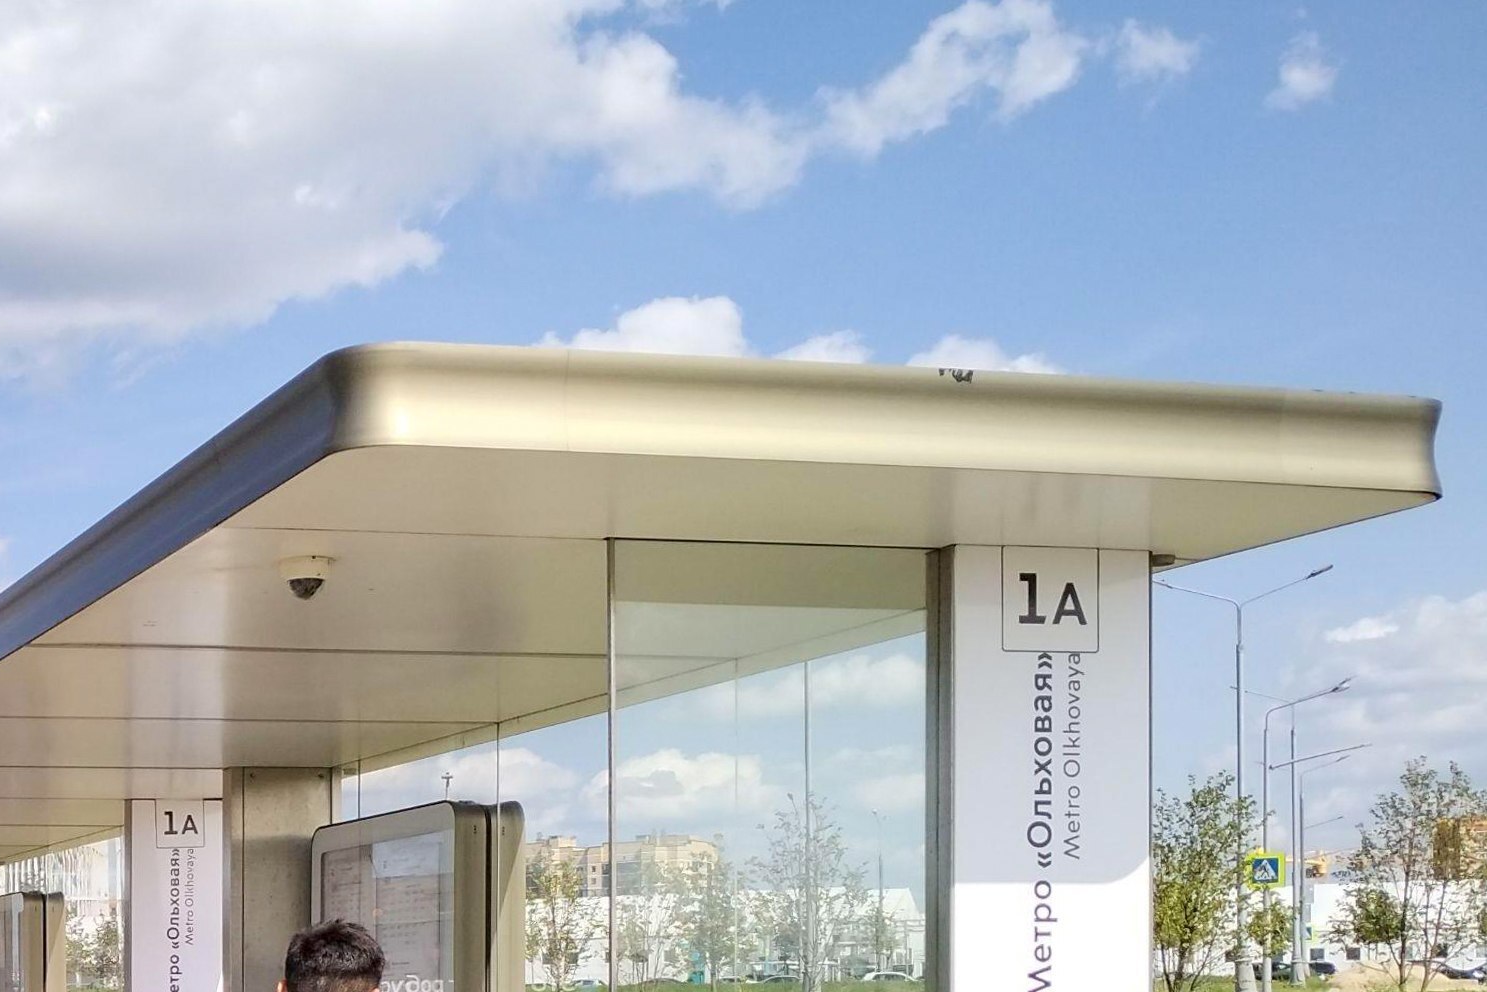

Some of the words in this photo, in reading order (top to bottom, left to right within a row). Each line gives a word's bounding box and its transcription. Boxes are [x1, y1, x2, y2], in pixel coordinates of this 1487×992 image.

[1027, 652, 1052, 868] «Ольховая»
[1063, 652, 1085, 777] Olkhovaya
[1063, 785, 1080, 859] Metro
[167, 848, 180, 949] «Ольховая»
[185, 910, 194, 945] Metro
